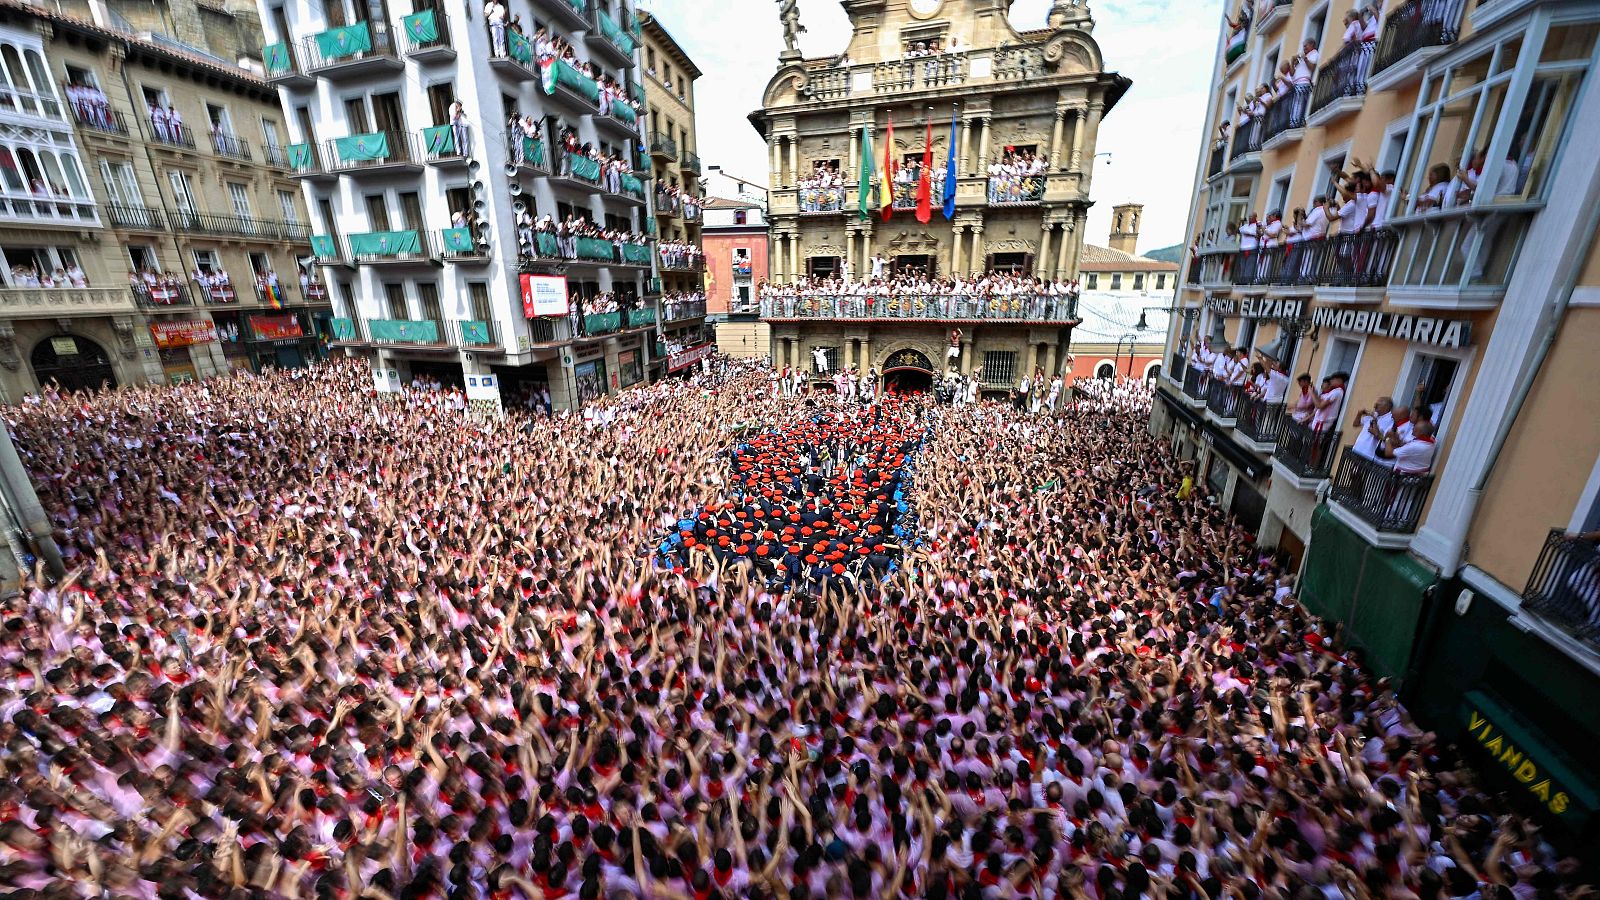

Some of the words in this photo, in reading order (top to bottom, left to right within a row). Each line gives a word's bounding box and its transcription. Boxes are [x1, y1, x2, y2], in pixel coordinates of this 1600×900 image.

[1204, 298, 1234, 314] GENCIA
[1240, 298, 1303, 318] ELIZARI
[1311, 306, 1462, 350] INMOBILIARIA
[1468, 711, 1569, 814] VIANDAS
